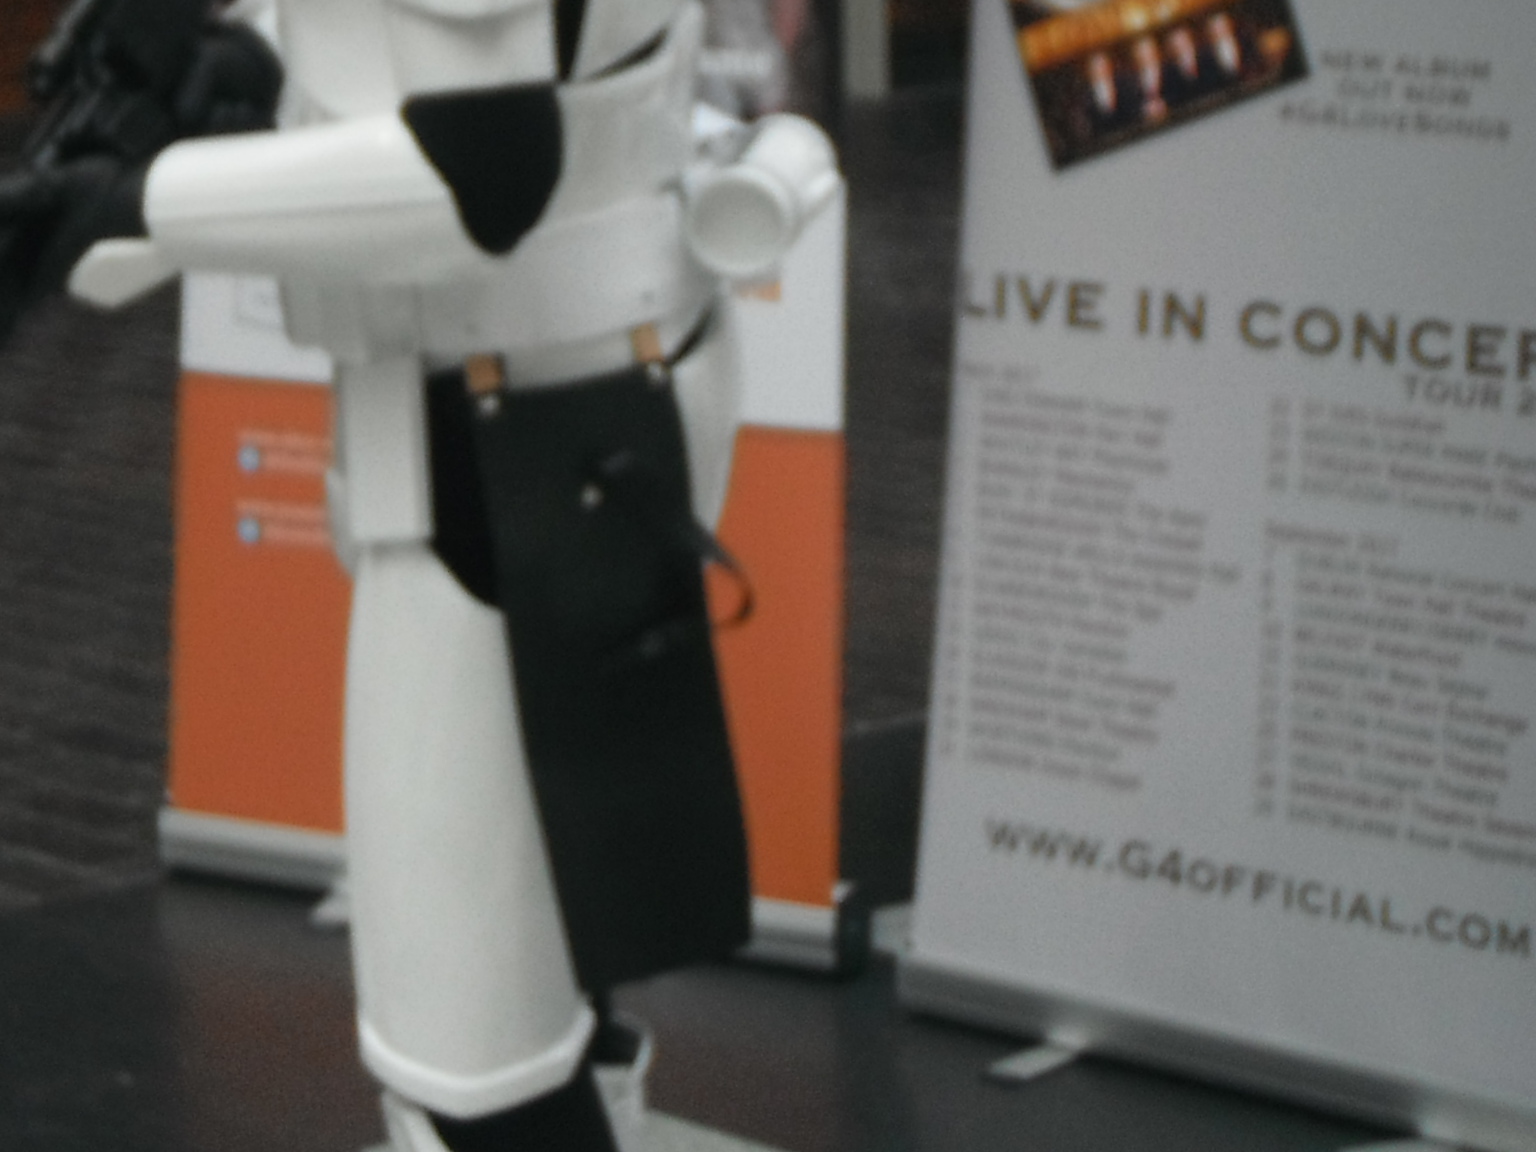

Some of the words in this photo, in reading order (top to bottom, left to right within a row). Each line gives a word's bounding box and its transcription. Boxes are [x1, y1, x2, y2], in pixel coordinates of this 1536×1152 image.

[962, 272, 1106, 332] LIVE
[1136, 287, 1207, 342] IN
[1404, 372, 1504, 413] TOUR
[983, 815, 1534, 958] WWW.G4OFFICIAL.COM
